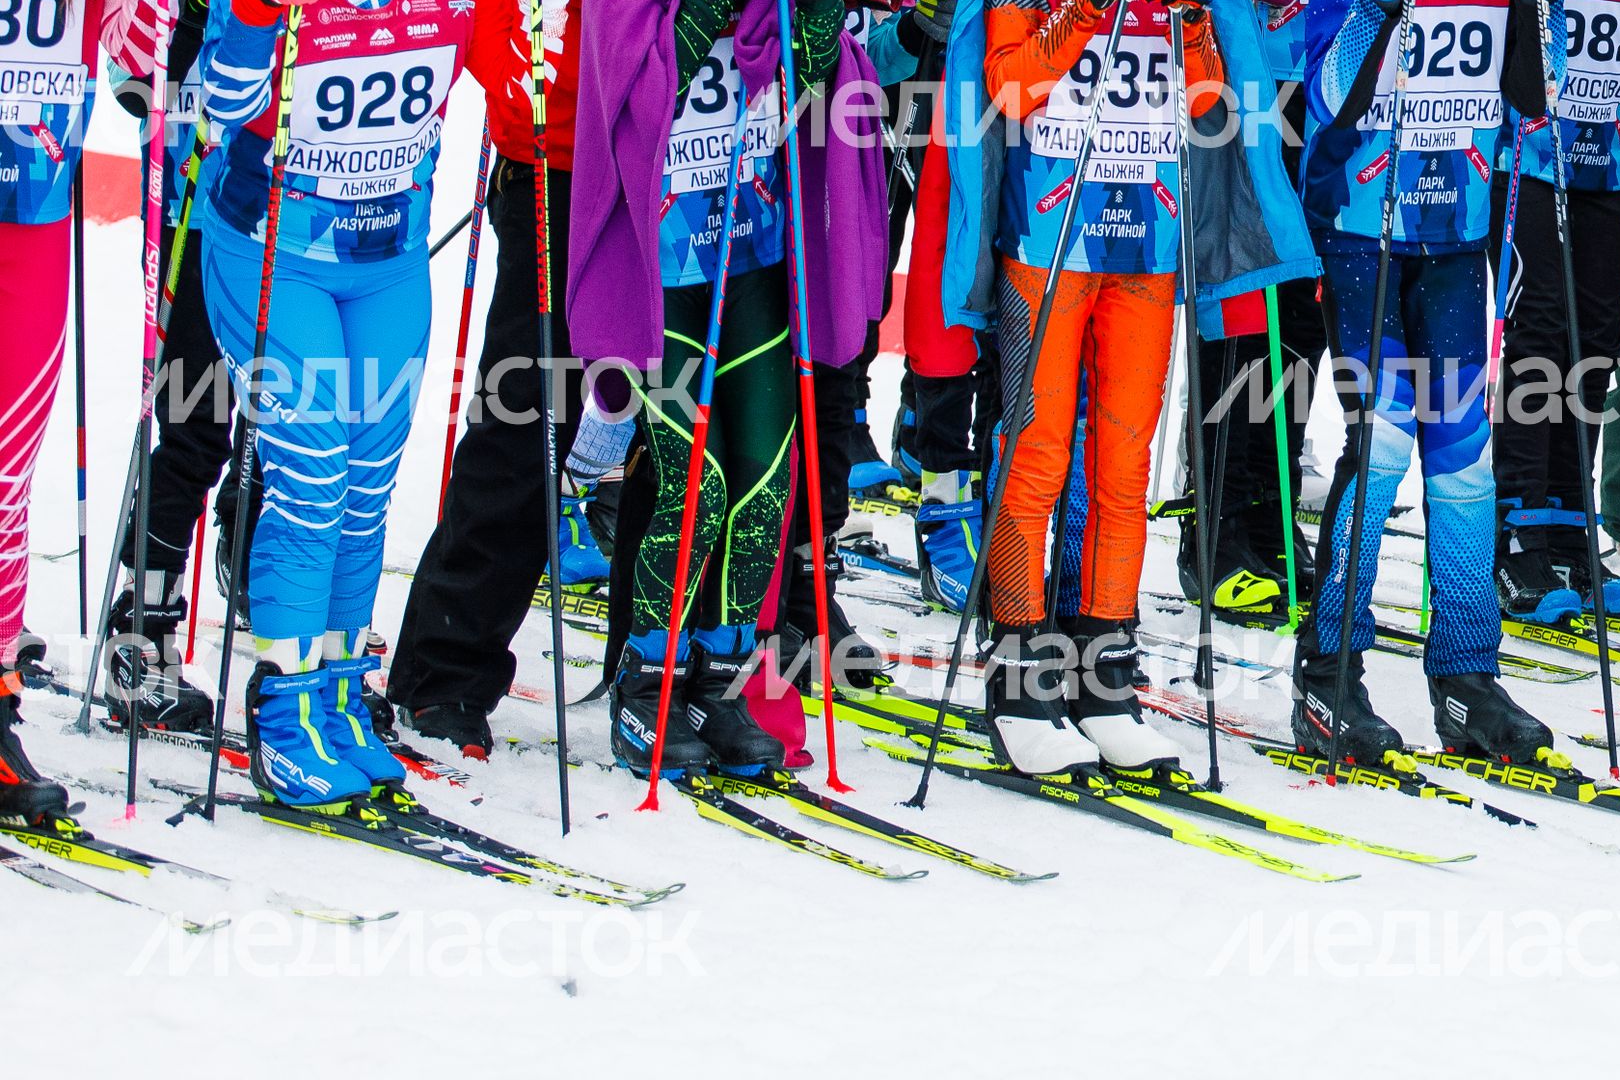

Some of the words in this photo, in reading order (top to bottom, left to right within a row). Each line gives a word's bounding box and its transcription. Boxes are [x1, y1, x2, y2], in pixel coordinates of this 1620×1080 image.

[407, 23, 439, 36] ЗИМА
[1408, 21, 1493, 78] 929
[1069, 51, 1169, 110] 935
[316, 66, 435, 132] 928
[1568, 106, 1612, 120] ЛЫЖНЯ
[1411, 131, 1456, 148] ЛЫЖНЯ
[1571, 141, 1600, 153] ПАРК
[1094, 163, 1145, 180] ЛЫЖНЯ
[340, 178, 397, 197] ЛЫЖНЯ
[1417, 176, 1445, 190] ПАРК
[1398, 188, 1458, 206] ЛАЗУТИНОЙ
[1102, 208, 1133, 222] ПАРК
[1082, 221, 1147, 238] ЛАЗУТИНОЙ
[145, 247, 161, 322] SPORT
[1521, 625, 1578, 648] FISCHER
[709, 661, 752, 673] SPINE
[274, 677, 321, 690] SPINE
[620, 707, 657, 745] SPINE
[260, 741, 332, 796] SPINE
[1266, 749, 1401, 791] FISCHER
[1412, 751, 1557, 793] FISCHER
[1040, 784, 1080, 803] FISCHER
[1115, 780, 1161, 799] FISCHER
